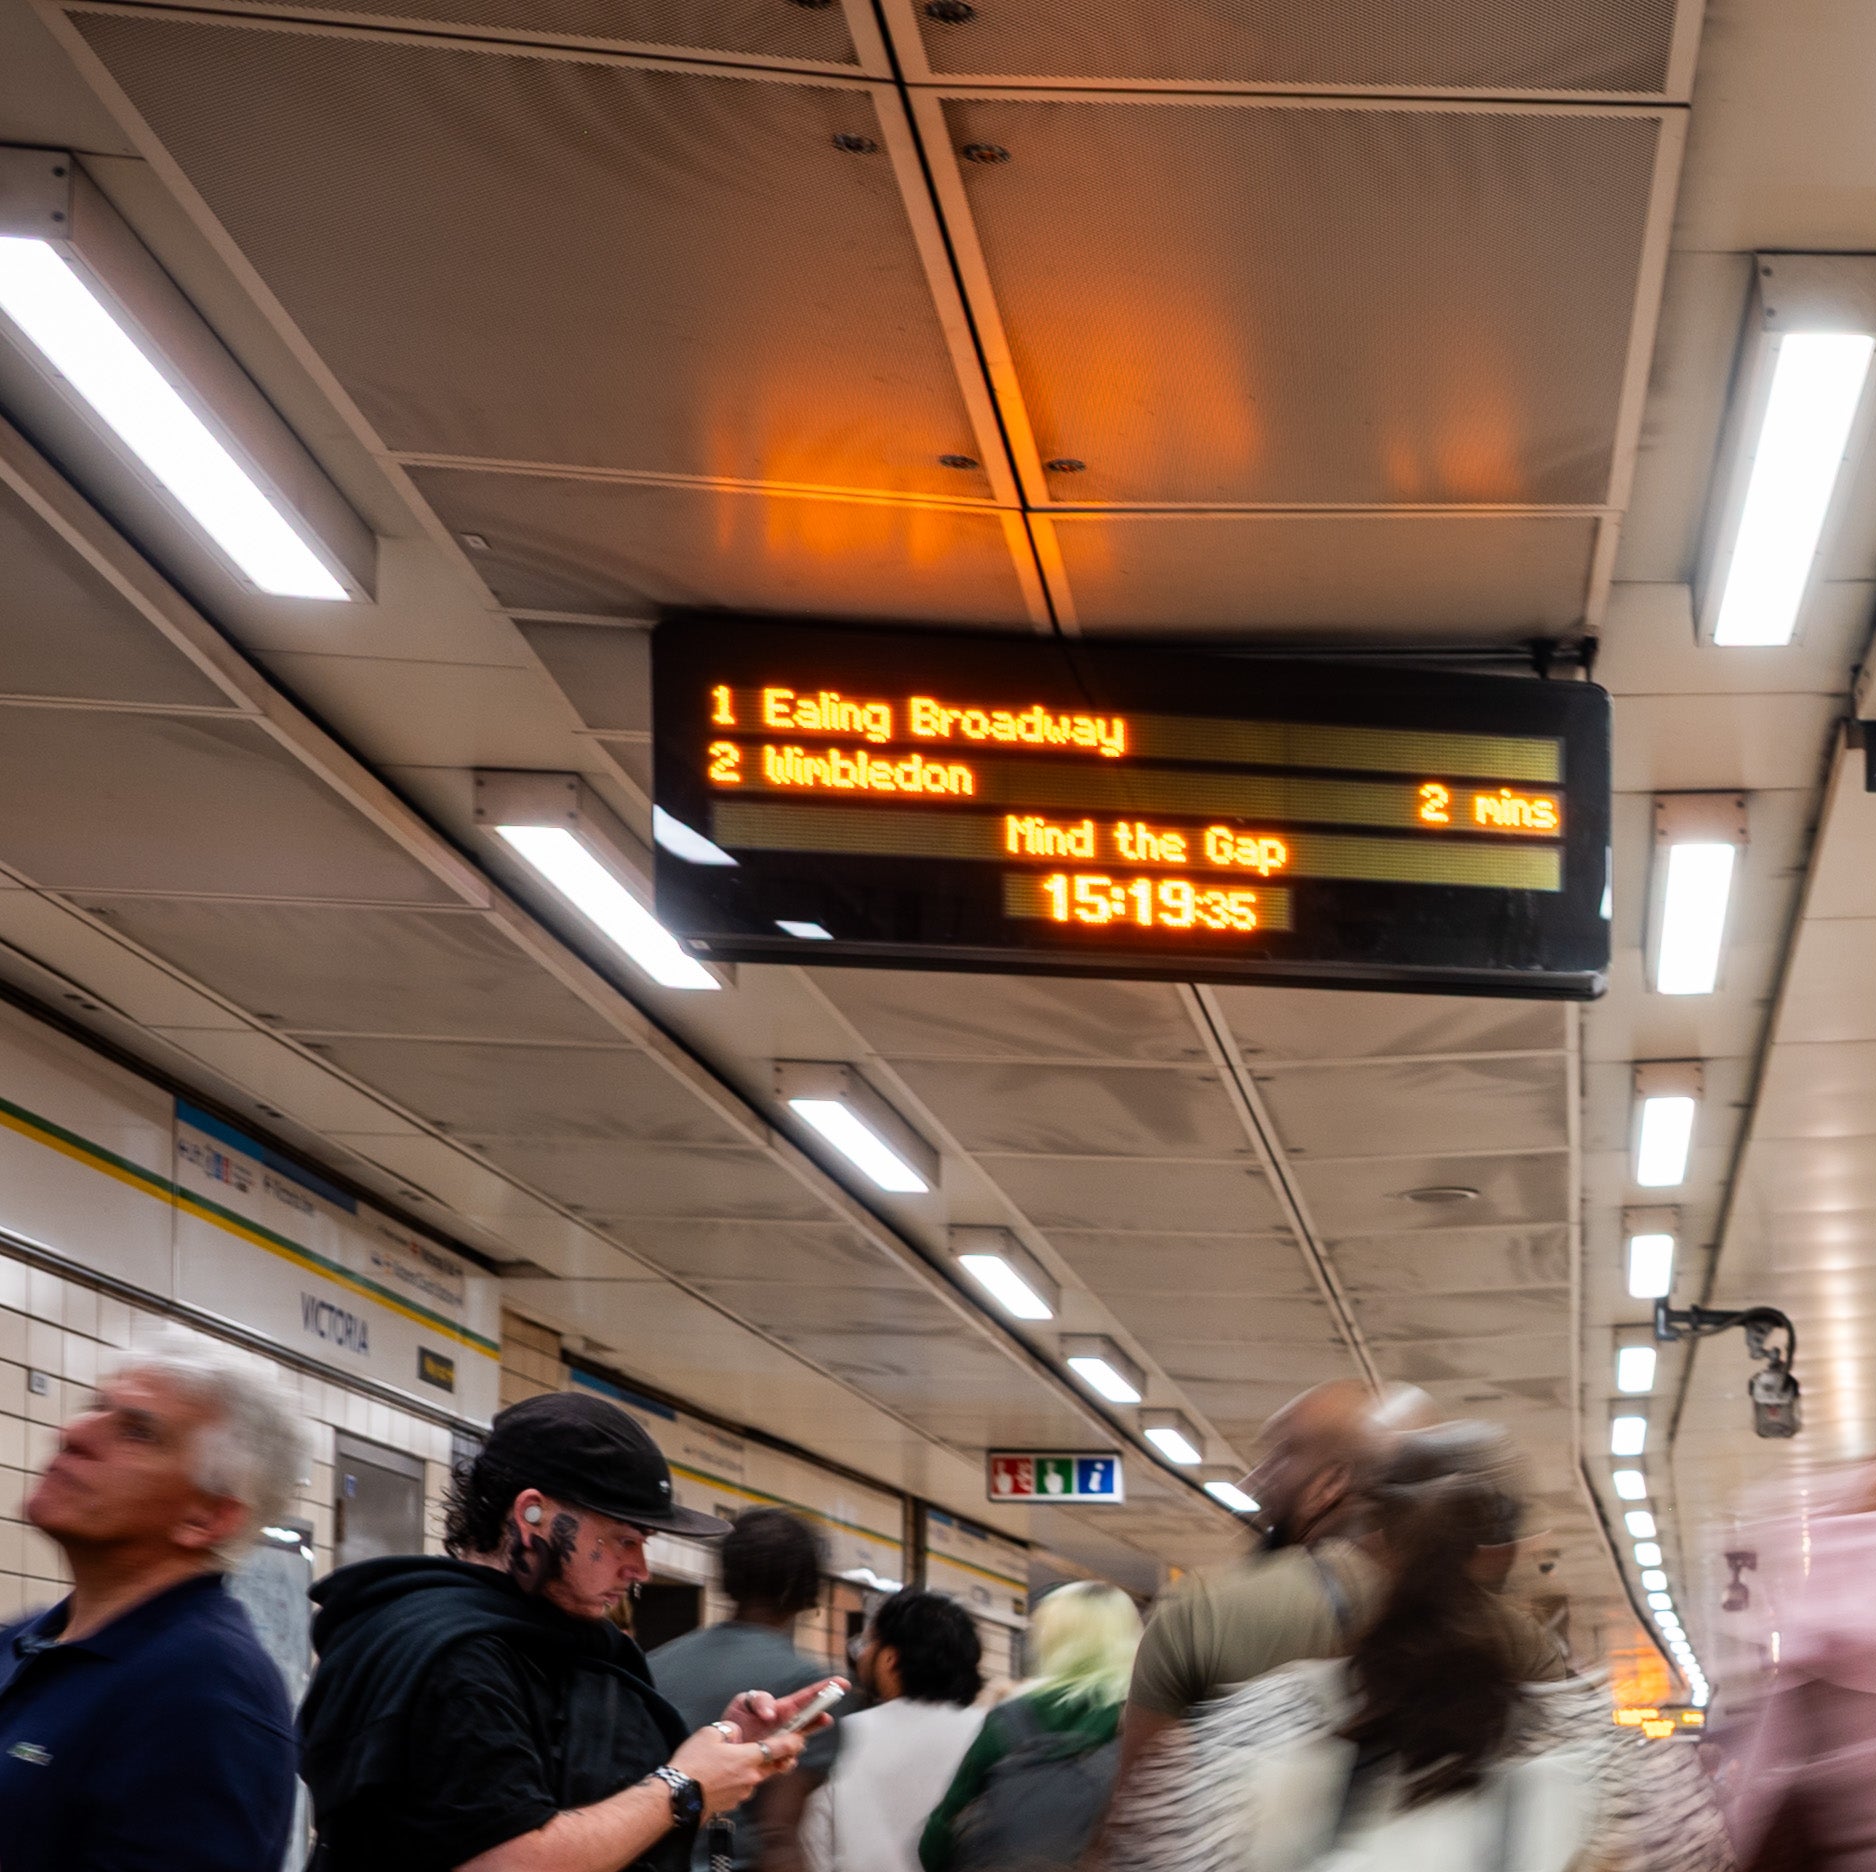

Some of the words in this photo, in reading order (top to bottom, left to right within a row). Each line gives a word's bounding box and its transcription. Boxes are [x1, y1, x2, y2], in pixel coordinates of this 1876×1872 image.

[712, 684, 736, 726] 1
[763, 687, 893, 744] Ealing
[910, 695, 1127, 758] Broadway
[708, 740, 741, 783] 2
[764, 744, 974, 796] Wimbledon
[1419, 783, 1450, 824] 2
[1475, 788, 1558, 829] mins
[1005, 814, 1095, 859] Mind
[1113, 821, 1187, 863] the
[1204, 825, 1288, 876] Gap
[300, 1291, 370, 1357] VICTORIA
